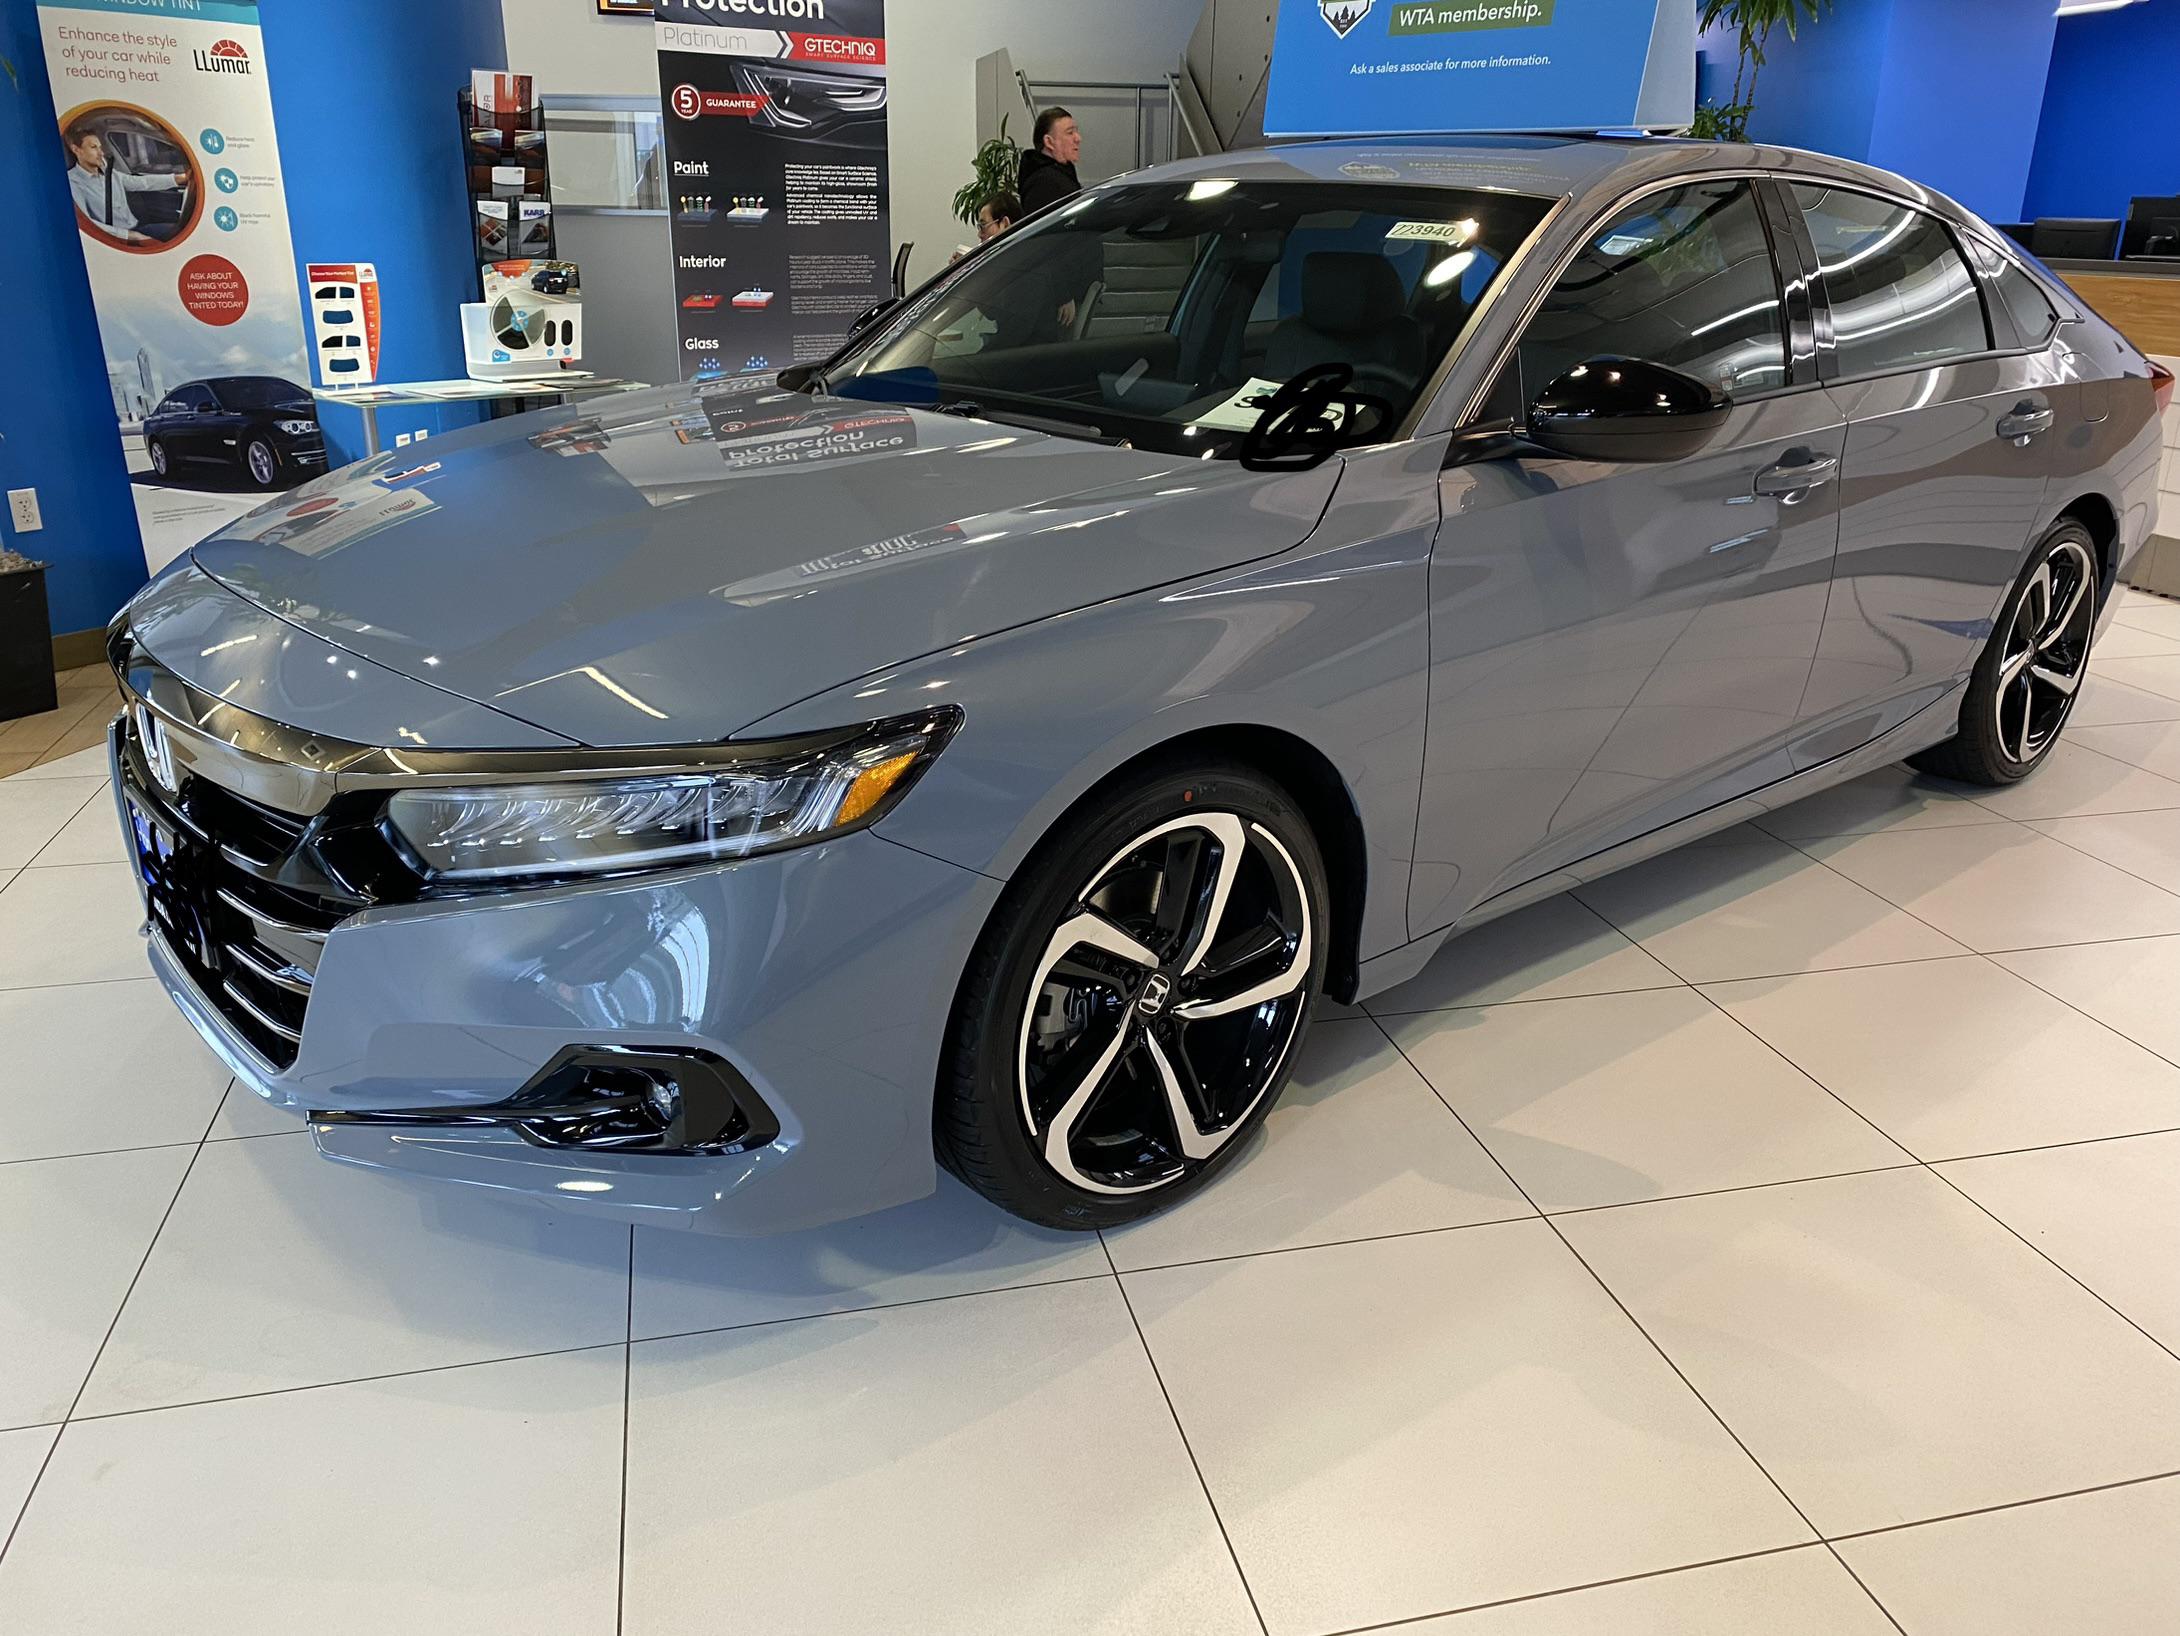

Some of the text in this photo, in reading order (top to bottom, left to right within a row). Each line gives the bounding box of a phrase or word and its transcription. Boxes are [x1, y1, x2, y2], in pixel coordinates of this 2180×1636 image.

[1400, 0, 1542, 27] WTA membership.
[58, 26, 177, 50] Enhance the style
[664, 26, 747, 48] Platinum
[62, 46, 171, 65] of your car while
[804, 38, 876, 56] GTECHNIQ
[193, 49, 250, 75] LLumar
[1350, 64, 1367, 74] Ask
[1376, 61, 1399, 73] sales
[1400, 60, 1442, 72] associate
[1444, 58, 1460, 69] for
[1461, 60, 1487, 69] more
[1489, 55, 1551, 67] information.
[66, 66, 159, 83] reducing heat
[680, 90, 692, 108] 5
[706, 99, 756, 108] GUARANTEE
[674, 161, 709, 174] Paint
[680, 256, 726, 268] Interior
[685, 338, 719, 350] Glass
